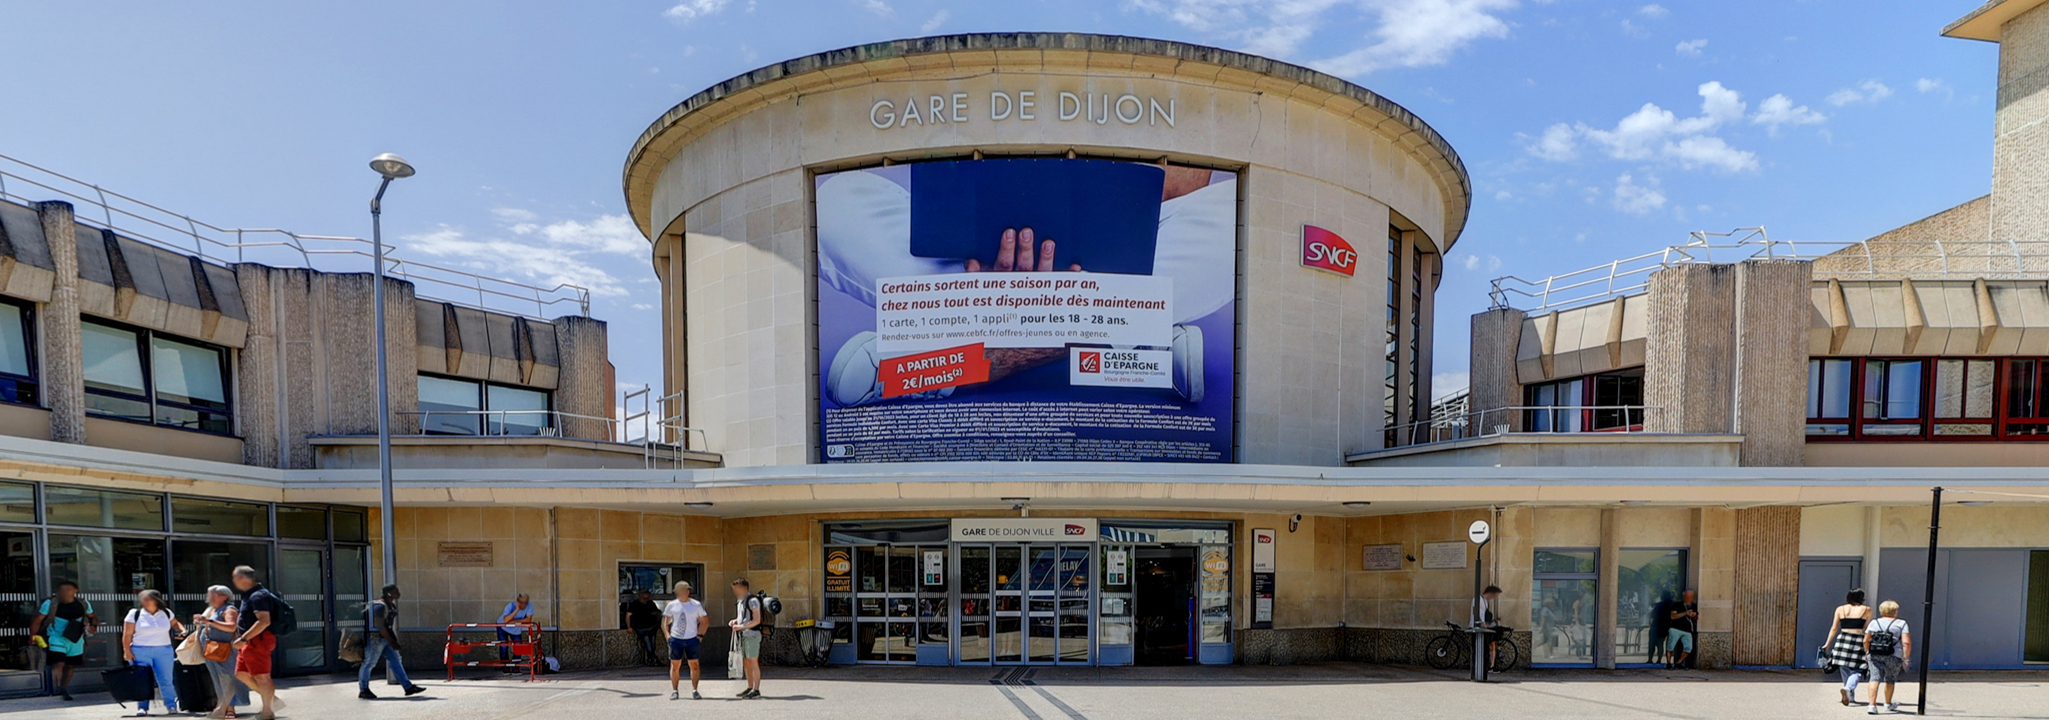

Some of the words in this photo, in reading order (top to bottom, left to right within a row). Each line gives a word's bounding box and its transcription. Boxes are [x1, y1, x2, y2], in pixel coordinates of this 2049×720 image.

[869, 93, 968, 130] GARE
[990, 91, 1035, 121] DE
[1059, 92, 1175, 128] DIJON
[1306, 242, 1356, 268] SNCF
[881, 281, 931, 294] Certains
[934, 279, 980, 292] sortent
[983, 280, 1006, 290] une
[1009, 277, 1051, 290] saison
[1055, 280, 1078, 291] par
[1080, 280, 1100, 292] an,
[881, 299, 908, 311] chez
[911, 300, 940, 310] nous
[944, 298, 969, 309] tout
[973, 297, 992, 307] est
[996, 294, 1063, 309] disponible
[1066, 294, 1089, 307] dès
[1092, 296, 1166, 310] maintenant
[882, 319, 887, 328] 1
[889, 318, 918, 328] carte,
[921, 317, 926, 326] 1
[929, 316, 970, 327] compte,
[973, 314, 978, 323] 1
[1020, 315, 1046, 326] pour
[1049, 313, 1065, 323] les
[1068, 314, 1080, 323] 18
[1091, 315, 1104, 324] 28
[1107, 316, 1129, 326] ans.
[882, 332, 930, 341] Rendez-vous
[946, 328, 1053, 339] www.cebfc.fr/offres-jeunes
[1055, 330, 1065, 338] ou
[1067, 330, 1078, 338] en
[1080, 331, 1110, 340] agence.
[897, 363, 906, 374] A
[907, 355, 948, 372] PARTIR
[950, 352, 966, 365] DE
[1104, 352, 1139, 361] CAISSE
[1104, 361, 1159, 371] D'EPARGNE
[961, 527, 987, 536] GARE
[989, 528, 1000, 536] DE
[1003, 527, 1031, 536] DIJON
[1032, 527, 1055, 536] VILLE
[1065, 528, 1084, 536] SNCF
